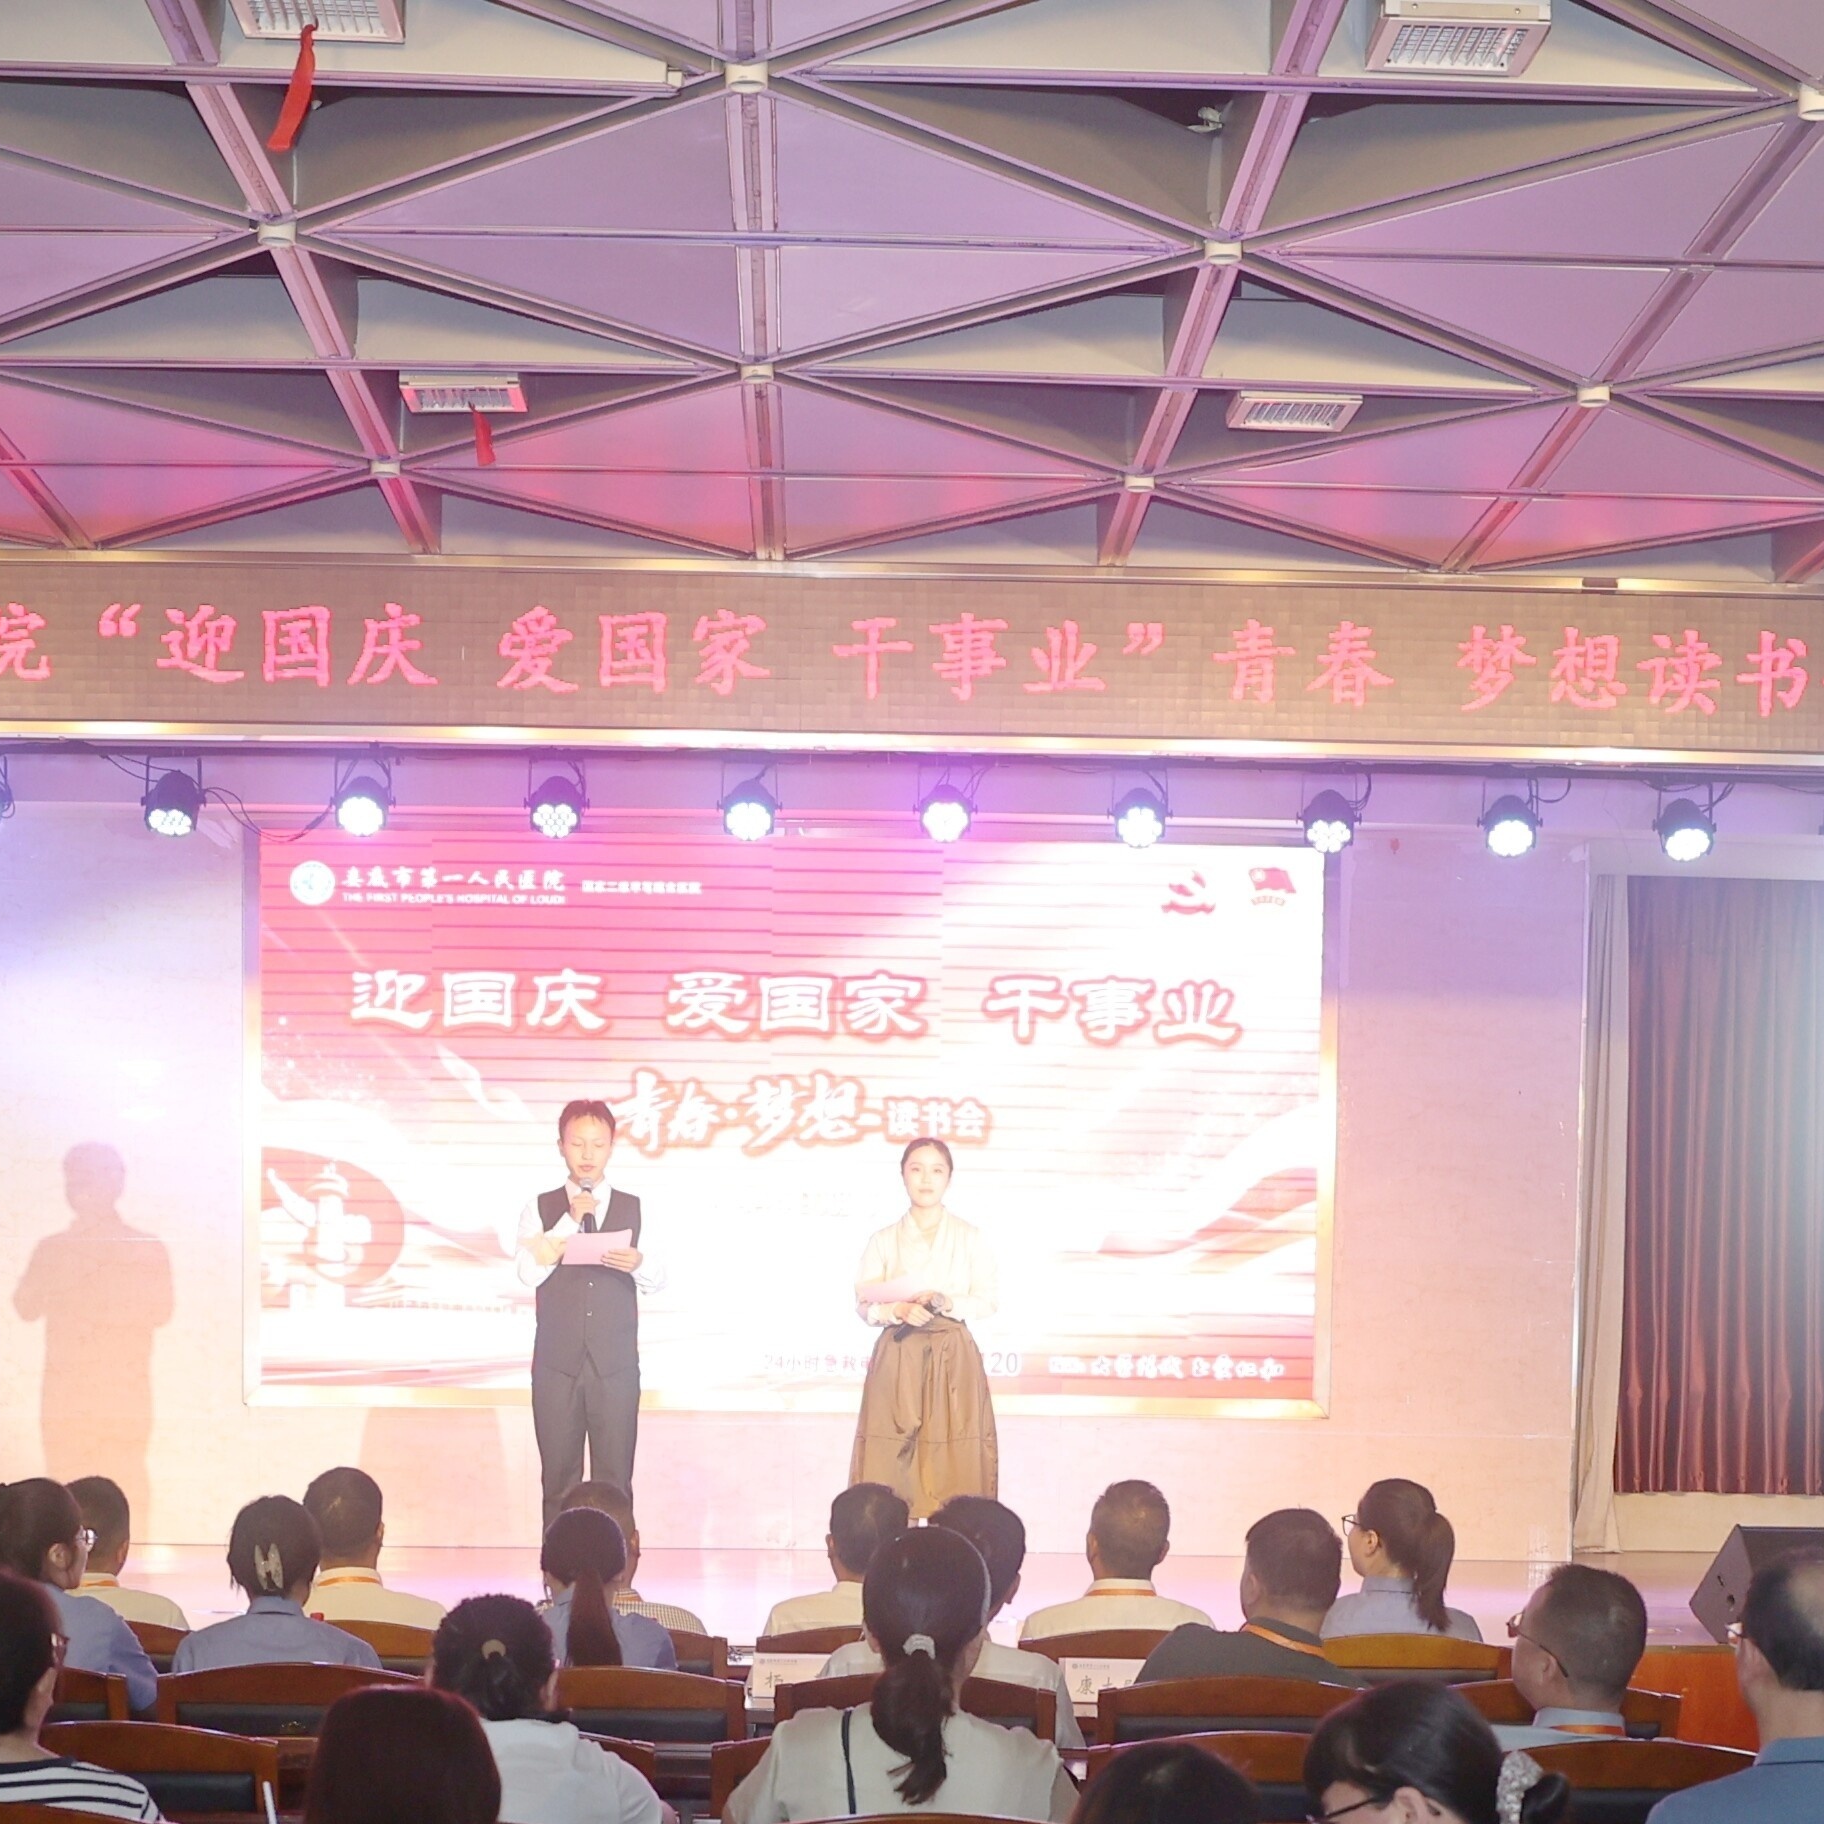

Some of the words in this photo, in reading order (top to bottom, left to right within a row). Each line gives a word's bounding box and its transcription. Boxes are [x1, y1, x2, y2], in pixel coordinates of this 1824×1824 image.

[496, 604, 770, 696] 爱国家
[343, 893, 363, 903] THE
[348, 967, 608, 1033] 迎国庆
[665, 970, 929, 1040] 爱国家
[985, 975, 1241, 1046] 干事业
